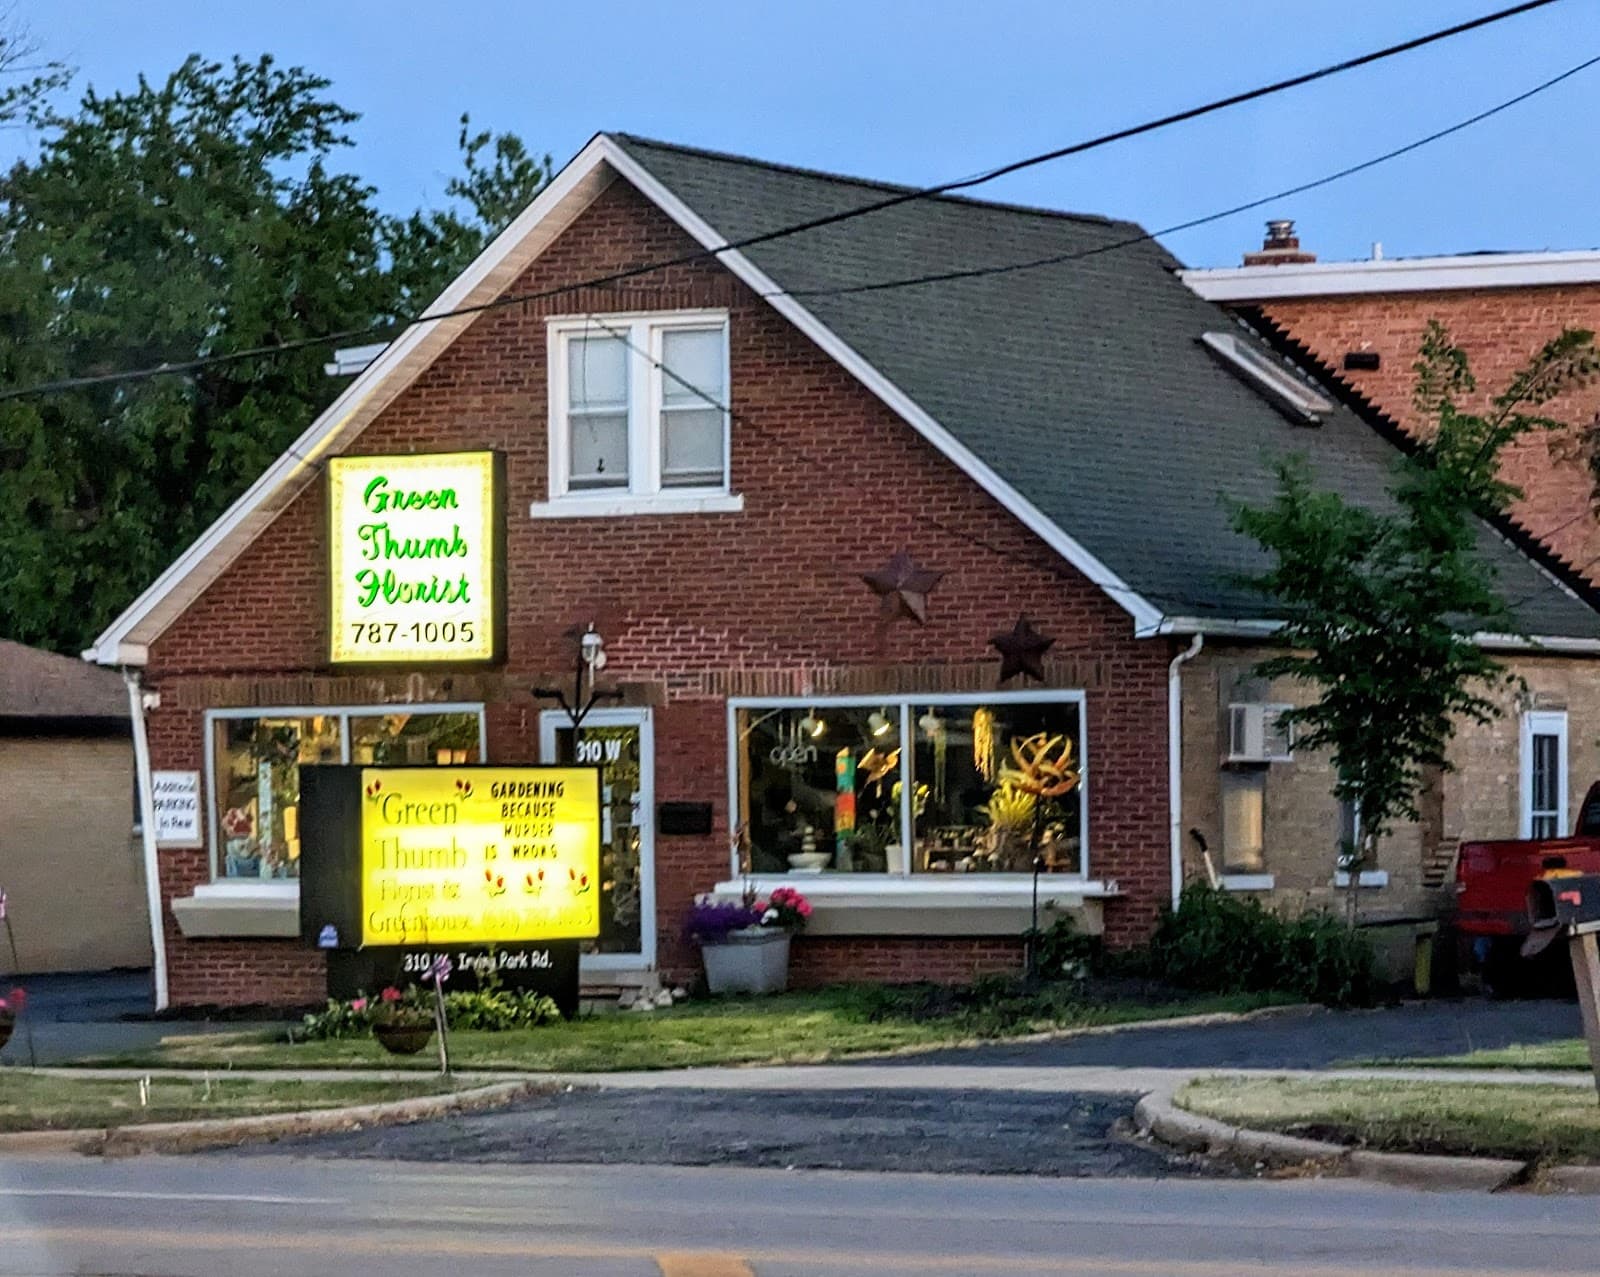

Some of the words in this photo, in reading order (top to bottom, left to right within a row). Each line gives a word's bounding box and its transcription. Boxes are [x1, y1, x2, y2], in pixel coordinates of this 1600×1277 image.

[363, 475, 459, 513] Green
[358, 522, 468, 561] Thumb
[355, 568, 471, 607] Florist
[351, 622, 475, 644] 787-1005
[577, 741, 601, 762] 310
[605, 740, 622, 761] W
[769, 743, 818, 767] open
[491, 781, 565, 798] GARDENING
[382, 792, 458, 825] Green
[501, 802, 557, 818] BECAUSE
[504, 823, 554, 838] MURDER
[373, 836, 467, 870] Thumb
[485, 845, 497, 860] IS
[512, 844, 558, 859] WRONG
[380, 878, 435, 902] Florist
[403, 953, 431, 972] 310
[499, 950, 530, 970] Park
[531, 949, 554, 969] Rd.
